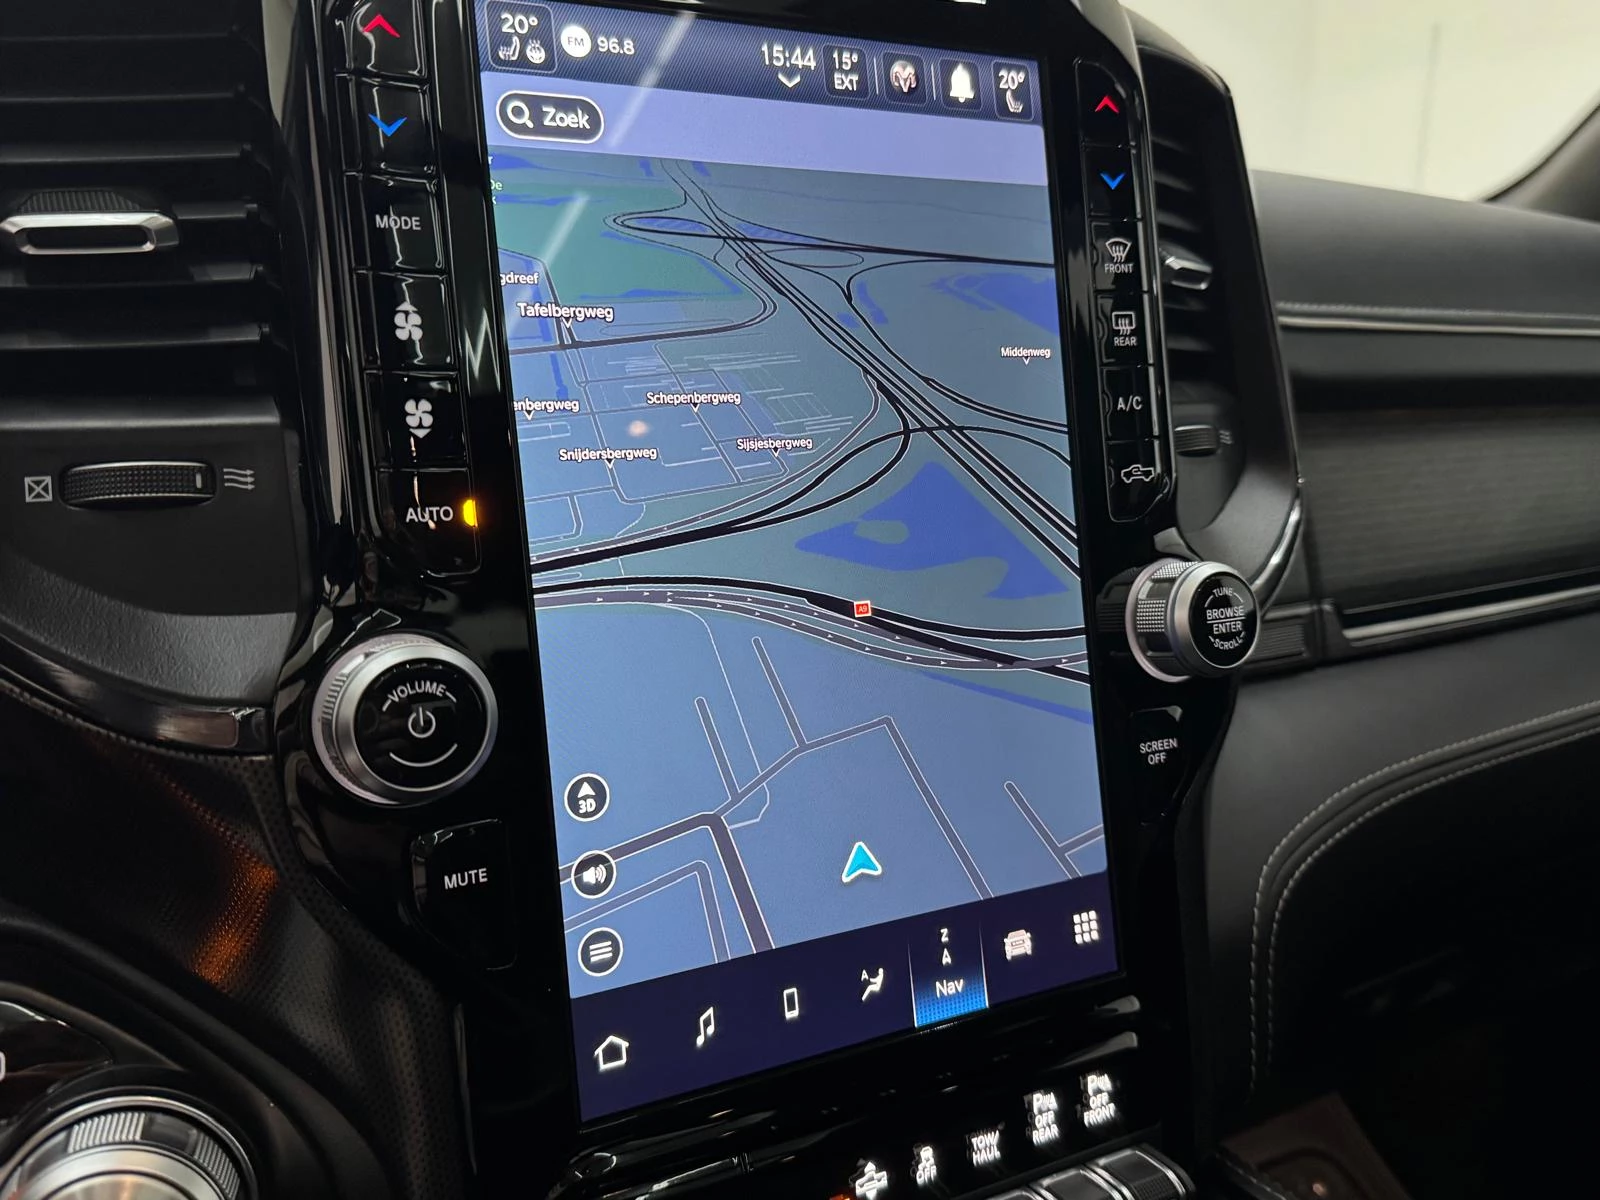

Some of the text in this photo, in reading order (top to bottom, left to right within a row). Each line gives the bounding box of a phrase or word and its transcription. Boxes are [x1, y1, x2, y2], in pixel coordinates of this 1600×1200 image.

[567, 36, 585, 48] FM
[597, 37, 635, 55] 96.8
[761, 43, 816, 70] 15:44
[834, 72, 859, 91] EXT
[541, 106, 591, 130] Zoek
[375, 214, 421, 231] MODE
[1104, 263, 1134, 274] FRONT
[517, 303, 614, 323] Tafelbergweg
[1113, 336, 1138, 347] REAR
[1000, 346, 1051, 359] Middenweg
[646, 391, 742, 408] Schepenbergweg
[1117, 396, 1143, 412] A/C
[736, 436, 813, 452] Sijsjesbergweg
[559, 447, 658, 463] Snijdersbergweg
[406, 506, 454, 524] AUTO
[1212, 586, 1233, 598] TUNE
[1206, 605, 1246, 620] BROWSE
[1212, 621, 1243, 635] ENTER
[1213, 636, 1243, 650] SCROLL
[387, 680, 447, 703] VOLUME
[1139, 737, 1178, 754] SCREEN
[1147, 752, 1167, 765] OFF
[578, 801, 597, 814] 3D
[443, 867, 488, 890] MUTE
[935, 978, 964, 999] Nav
[1089, 1092, 1110, 1110] OFF
[1034, 1111, 1055, 1130] OFF
[1083, 1103, 1117, 1128] FRONT
[1032, 1124, 1060, 1146] REAR
[972, 1147, 1000, 1168] HAUL
[916, 1165, 937, 1186] OFF
